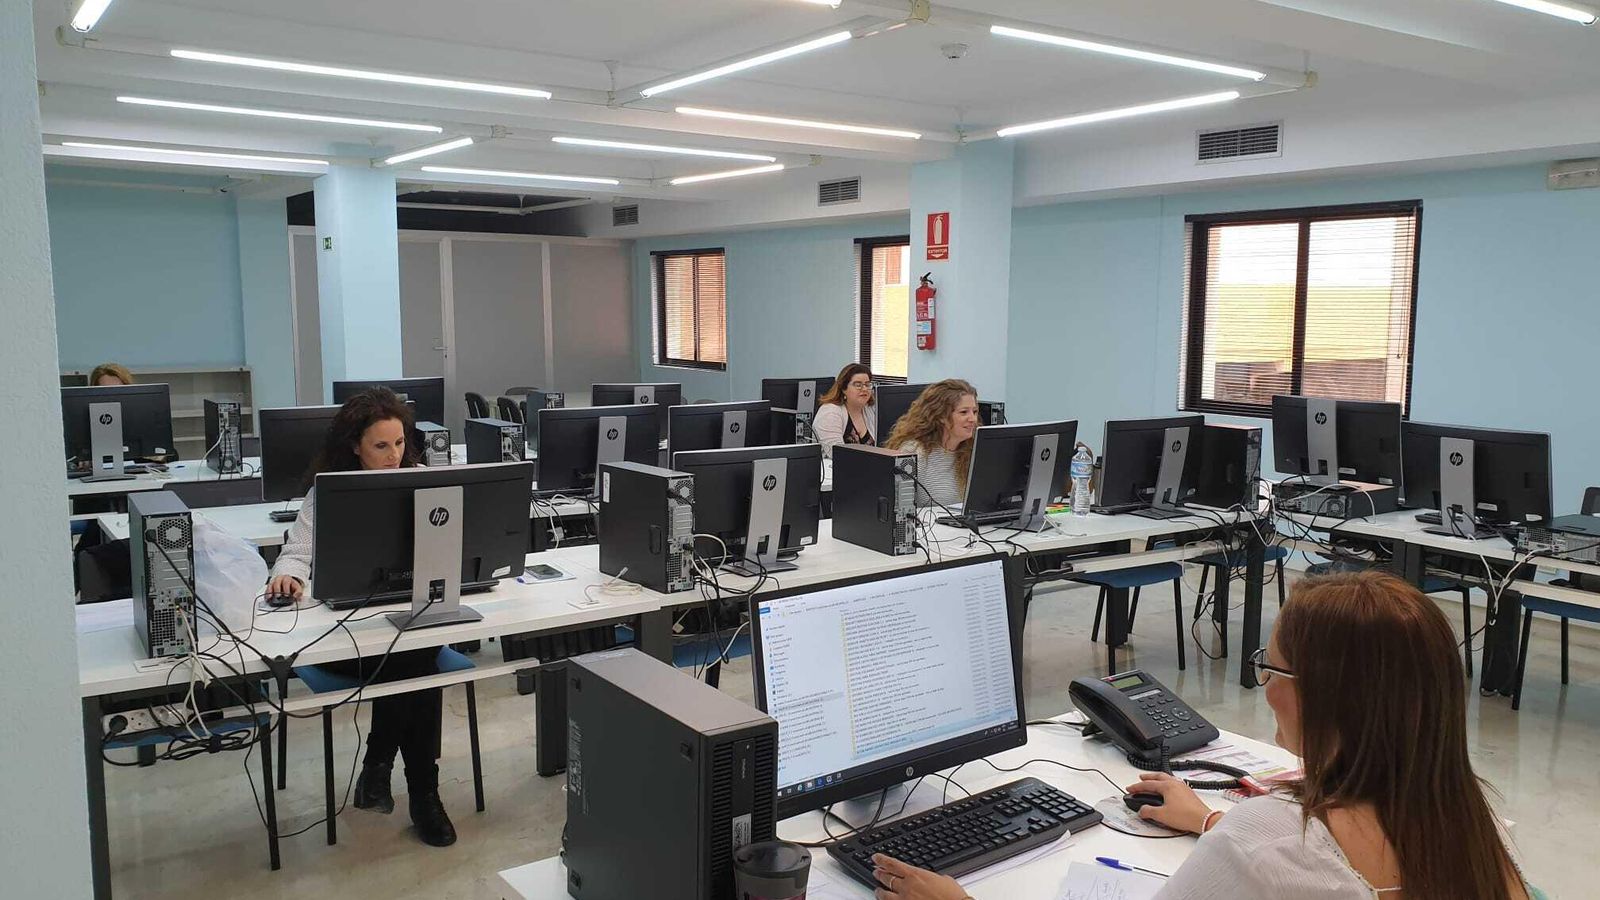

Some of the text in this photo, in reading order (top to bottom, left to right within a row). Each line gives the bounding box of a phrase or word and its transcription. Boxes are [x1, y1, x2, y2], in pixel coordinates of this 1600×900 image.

[100, 414, 112, 425] hp
[1315, 412, 1327, 425] hp
[607, 428, 618, 440] hp
[1449, 452, 1463, 466] hp
[763, 475, 777, 491] hp
[429, 507, 449, 526] hp
